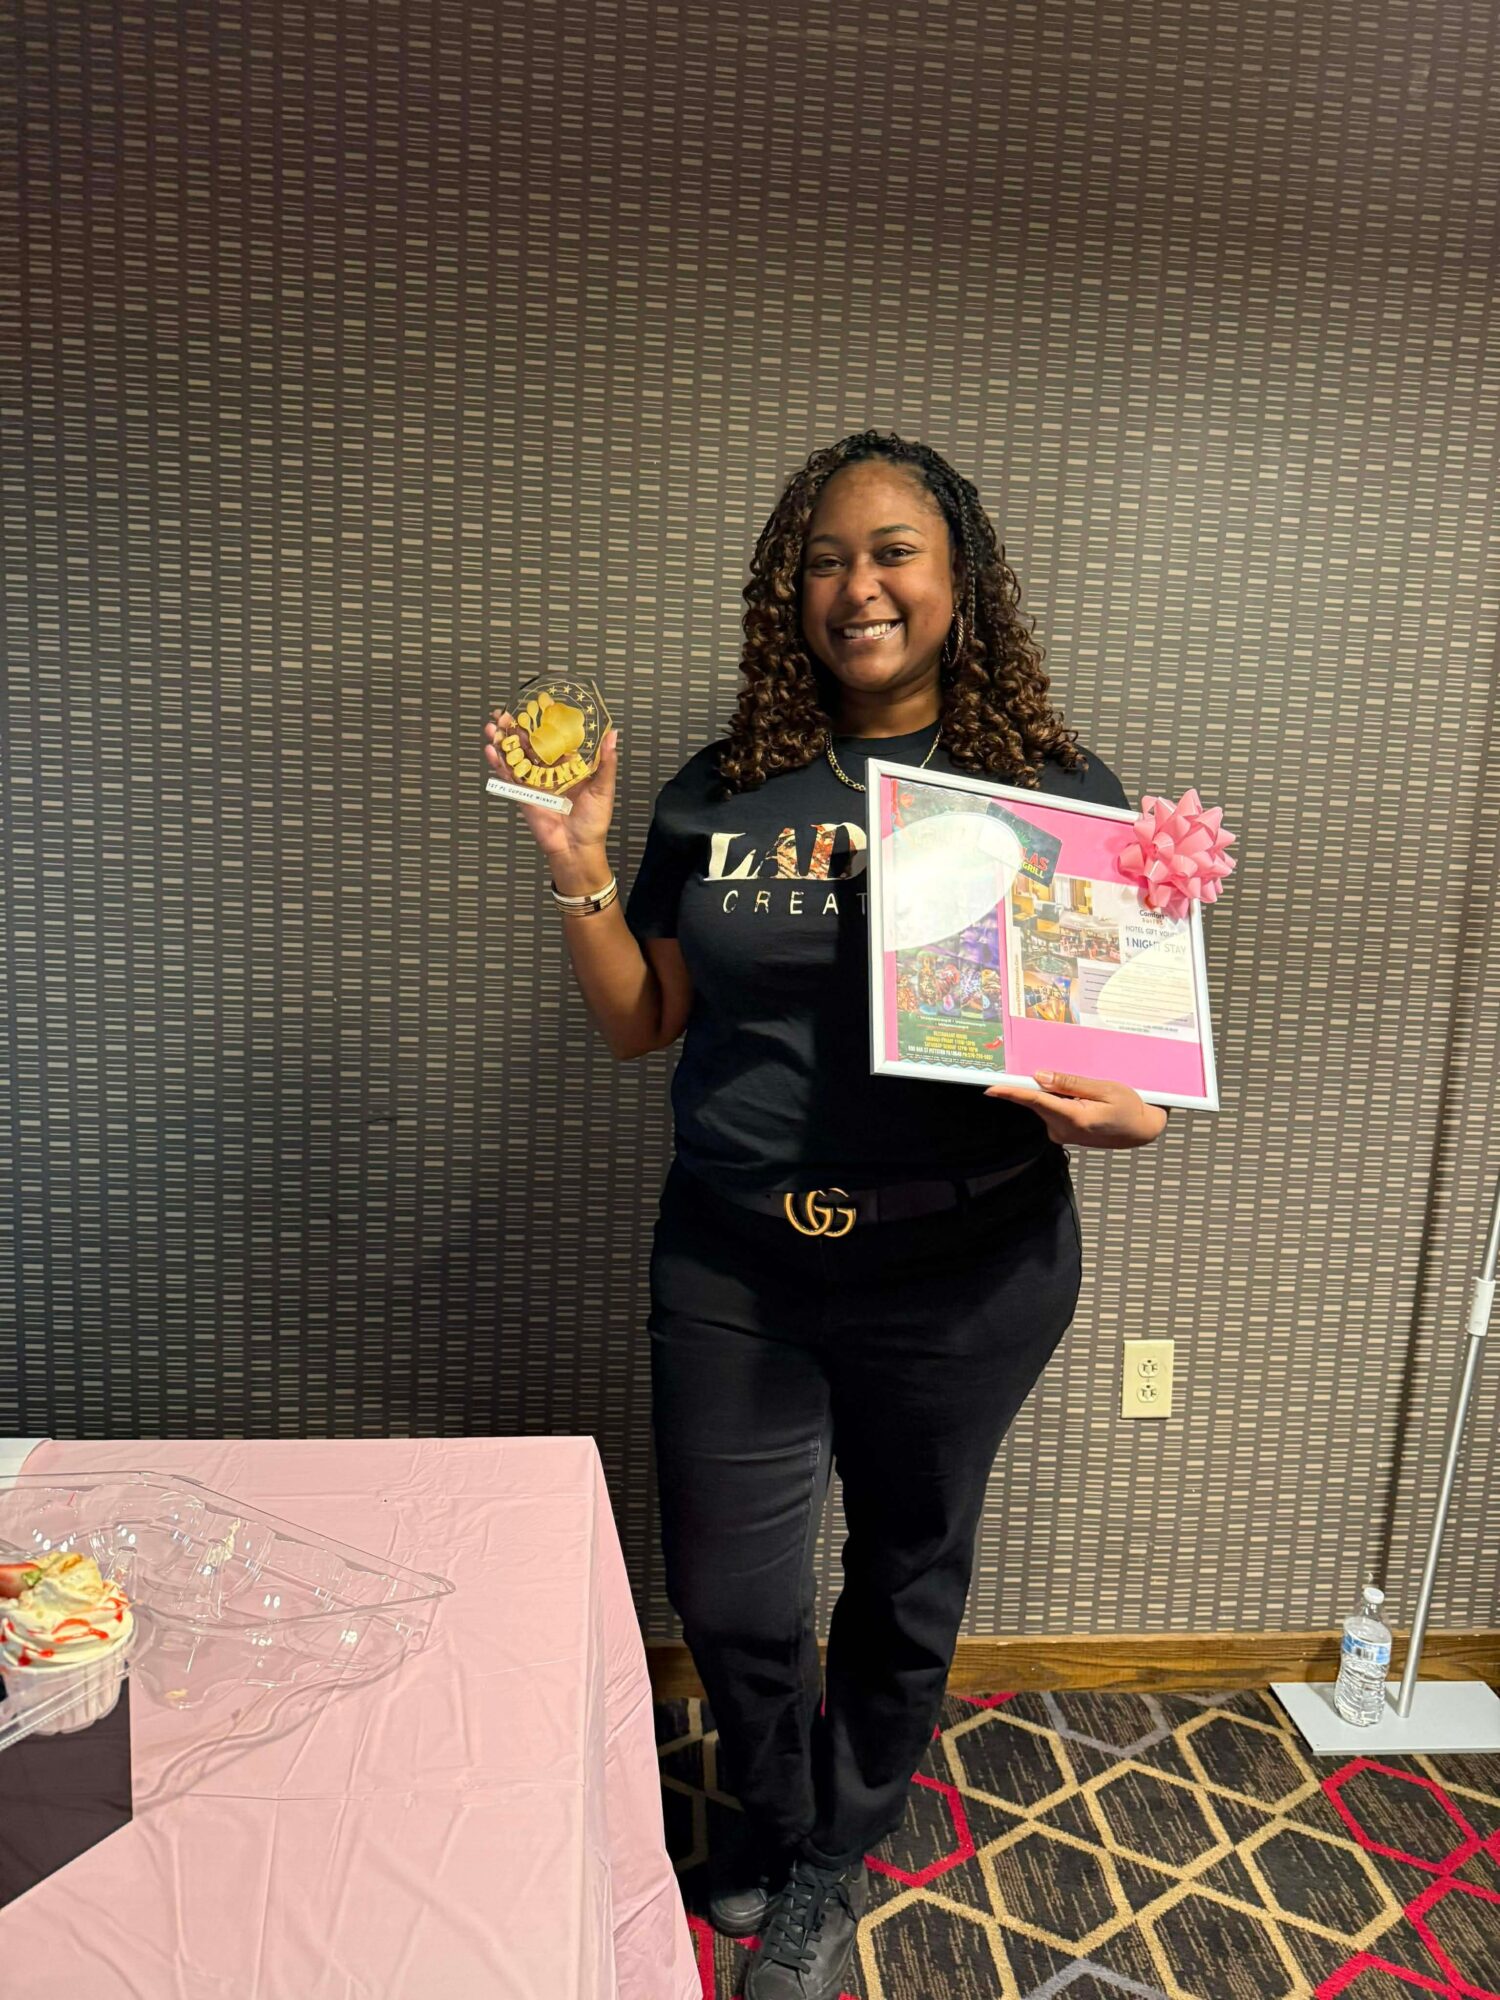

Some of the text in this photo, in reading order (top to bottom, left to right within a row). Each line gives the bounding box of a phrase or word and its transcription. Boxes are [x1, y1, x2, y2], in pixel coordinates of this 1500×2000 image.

[1022, 861, 1045, 879] GRILL
[1131, 937, 1161, 952] NIGHT
[1164, 943, 1186, 956] STAY
